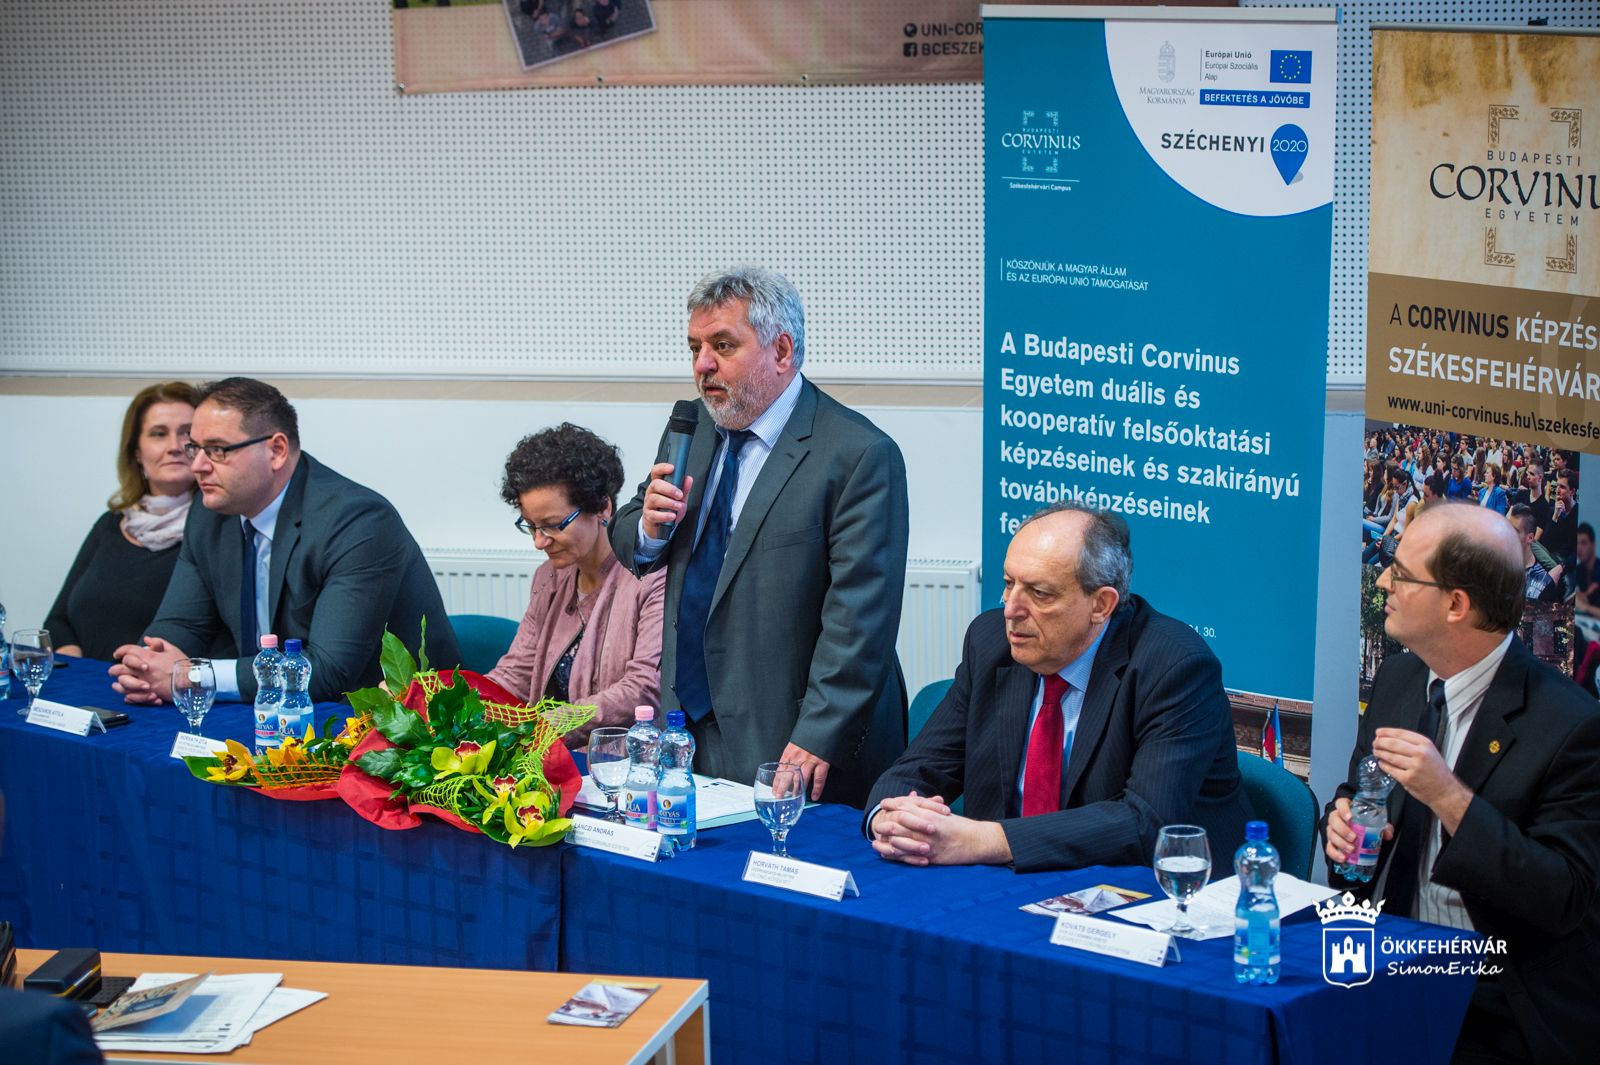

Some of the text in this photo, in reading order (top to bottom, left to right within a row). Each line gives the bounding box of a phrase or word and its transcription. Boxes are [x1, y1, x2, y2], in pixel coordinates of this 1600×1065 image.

[1205, 50, 1252, 59] Európai Unió
[1205, 61, 1258, 71] Európai Szociális
[1204, 73, 1218, 82] Alap
[1204, 92, 1258, 103] BEFEKTETÉS
[1260, 95, 1267, 104] A
[1001, 132, 1081, 150] CORVINUS
[1161, 129, 1308, 153] SZÉCHENYI 2020
[1487, 150, 1581, 167] BUDAPESTI
[1485, 207, 1579, 226] EGYETEM
[1006, 270, 1017, 282] ÉS
[1019, 273, 1030, 283] AZ
[1032, 273, 1068, 285] EURÓPAI
[1069, 275, 1090, 287] UNIÓ
[1057, 263, 1064, 272] A
[1065, 264, 1099, 274] MAGYAR
[1100, 264, 1127, 277] ÁLLAM
[1389, 303, 1600, 351] A CORVINUS KÉPZÉS
[1000, 331, 1240, 375] A Budapesti Corvinus
[1388, 342, 1600, 402] SZÉKESFEHÉRVÁR
[1001, 368, 1201, 409] Egyetem duális és
[1000, 404, 1271, 456] kooperatív felsőoktatási
[1000, 440, 1300, 500] képzéseinek és szakirányú
[1000, 477, 1210, 524] továbbképzéseinek
[1203, 626, 1217, 639] 30.
